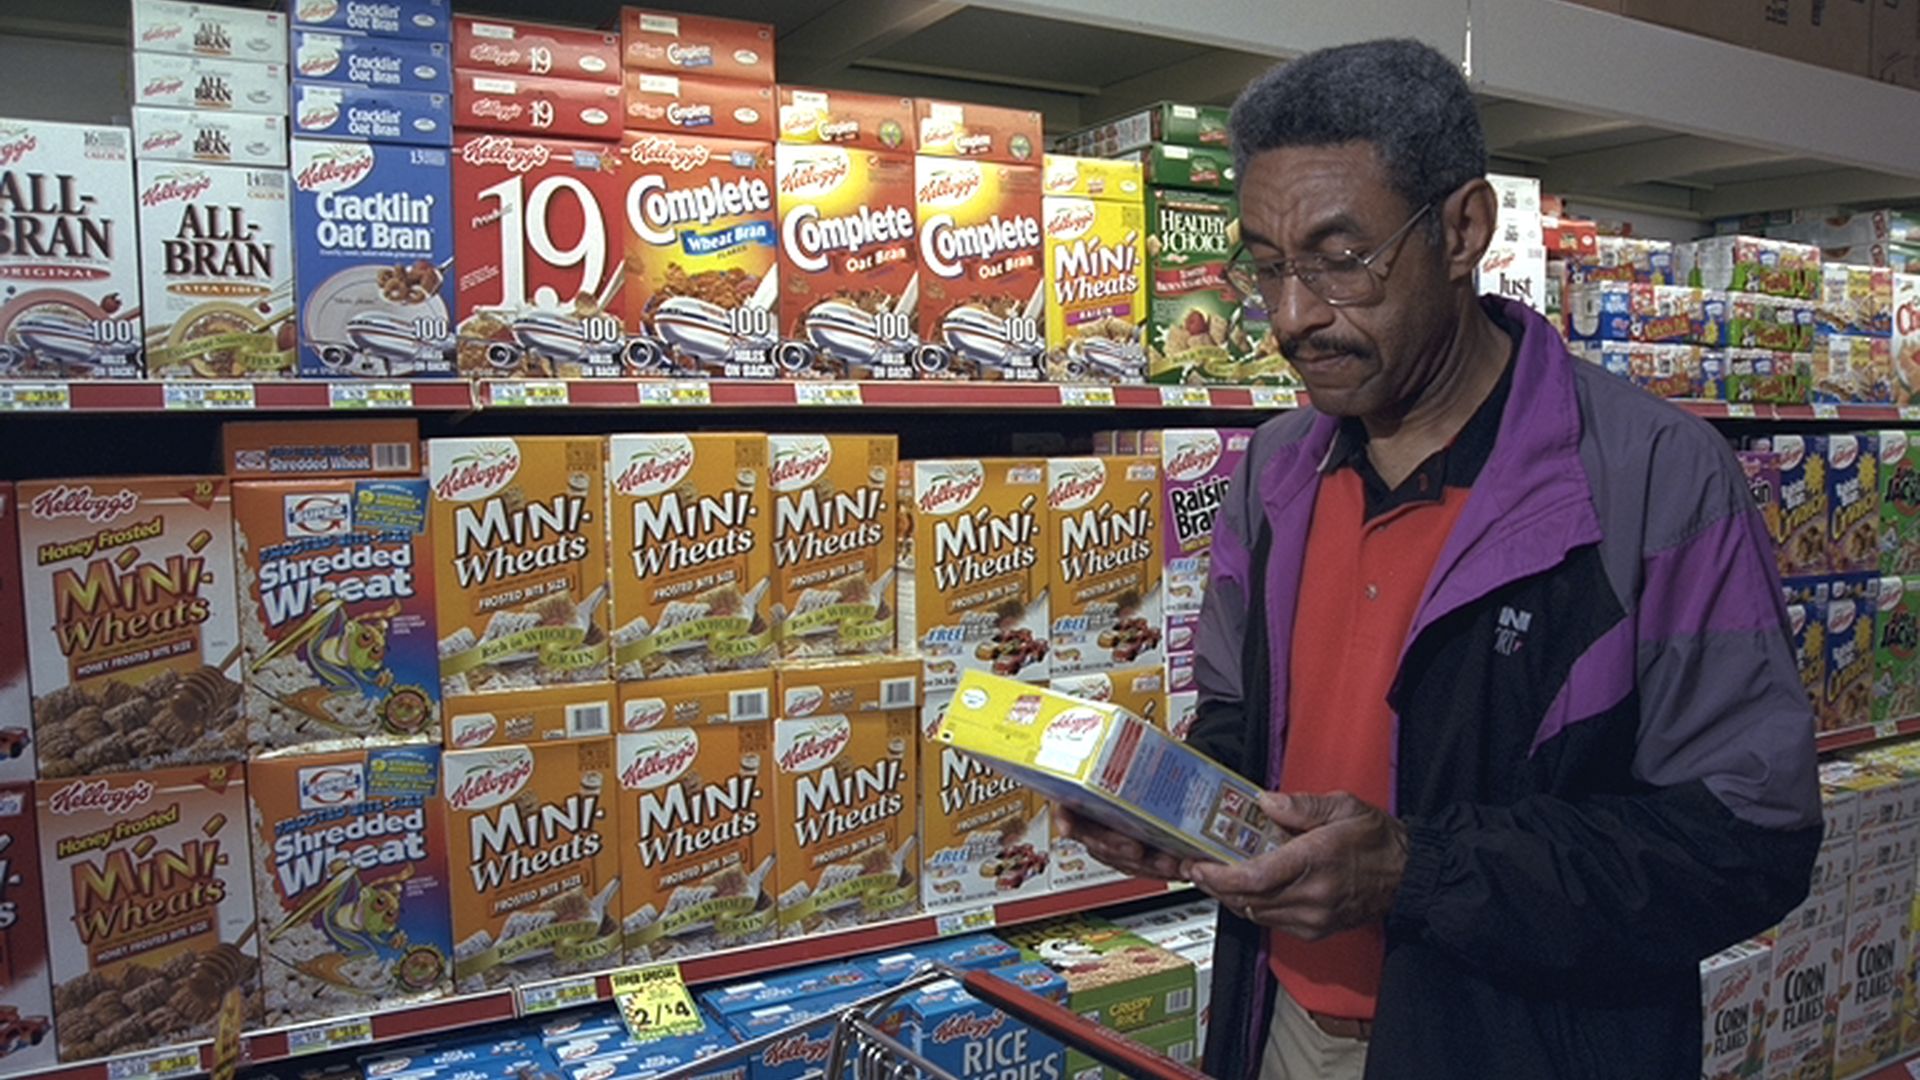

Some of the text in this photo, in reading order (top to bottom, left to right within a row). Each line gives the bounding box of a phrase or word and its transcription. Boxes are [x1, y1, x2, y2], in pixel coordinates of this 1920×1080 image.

[347, 16, 399, 31] Oat Bran
[194, 34, 231, 49] BRAN
[666, 43, 713, 64] Complete
[348, 67, 400, 83] Oat Bran
[527, 45, 552, 74] 19
[195, 87, 231, 102] BRAN
[348, 120, 400, 136] Oat Bran
[528, 100, 554, 129] 19
[666, 101, 713, 126] Complete
[818, 120, 859, 141] Complete
[194, 141, 231, 155] BRAN
[463, 135, 549, 172] Kellogg's
[631, 137, 709, 171] Kellogg's
[297, 154, 372, 190] Kellogg's
[780, 163, 847, 193] Kellogg's
[919, 175, 981, 203] Kellogg's
[142, 175, 211, 207] Kellogg's
[317, 191, 434, 224] Cracklin'
[176, 203, 260, 242] ALL-
[626, 175, 770, 245] Complete
[1047, 212, 1094, 234] Kellogg's
[317, 222, 431, 250] Oat Bran
[472, 174, 606, 314] 19
[685, 225, 767, 251] Wheat Bran
[782, 204, 914, 272] Complete
[919, 214, 1040, 278] Complete
[163, 240, 273, 277] BRAN
[846, 247, 907, 273] Oat Bran
[979, 254, 1034, 280] Oat Bran
[1055, 272, 1138, 304] Wheats
[1499, 271, 1532, 299] Just
[92, 319, 133, 345] 100
[413, 319, 448, 340] 100
[581, 319, 618, 342] 100
[730, 306, 769, 336] 100
[875, 313, 910, 340] 100
[1003, 317, 1037, 343] 100
[268, 457, 371, 473] Shredded Wheat
[436, 454, 518, 499] Kellogg's
[614, 451, 691, 494] Kellogg's
[769, 450, 830, 488] Kellogg's
[1168, 445, 1220, 478] Kellogg's
[33, 484, 139, 522] Kellogg's
[920, 474, 981, 513] Kellogg's
[1049, 473, 1104, 507] Kellogg's
[40, 516, 163, 565] Honey Frosted
[632, 529, 753, 579] Wheats
[773, 522, 883, 569] Wheats
[259, 544, 412, 591] Shredded
[453, 534, 588, 588] Wheats
[933, 545, 1036, 592] Wheats
[1060, 537, 1151, 584] Wheats
[261, 567, 414, 627] Wheat
[479, 590, 523, 609] FROSTED
[654, 580, 694, 599] FROSTED
[53, 598, 211, 657] Wheats
[112, 651, 151, 667] FROSTED
[623, 742, 697, 786] Kellogg's
[781, 727, 849, 771] Kellogg's
[50, 779, 155, 817] Kellogg's
[452, 758, 531, 808] Kellogg's
[58, 803, 180, 859] Honey Frosted
[274, 808, 424, 863] Shredded
[793, 793, 903, 848] Wheats
[637, 812, 758, 869] Wheats
[277, 832, 427, 898] Wheat
[470, 832, 602, 893] Wheats
[71, 880, 227, 945] Wheats
[1857, 939, 1896, 979] CORN
[613, 967, 676, 987] SUPER SPECIAL
[1783, 963, 1827, 1004] CORN
[1855, 969, 1894, 1005] FLAKES
[1109, 996, 1154, 1017] CRISPY
[1114, 1009, 1146, 1028] RICE
[1714, 1002, 1750, 1037] CORN
[1782, 999, 1825, 1032] FLAKES
[933, 1009, 1006, 1043] Kellogg's
[1713, 1028, 1749, 1058] FLAKES
[963, 1028, 1028, 1076] RICE
